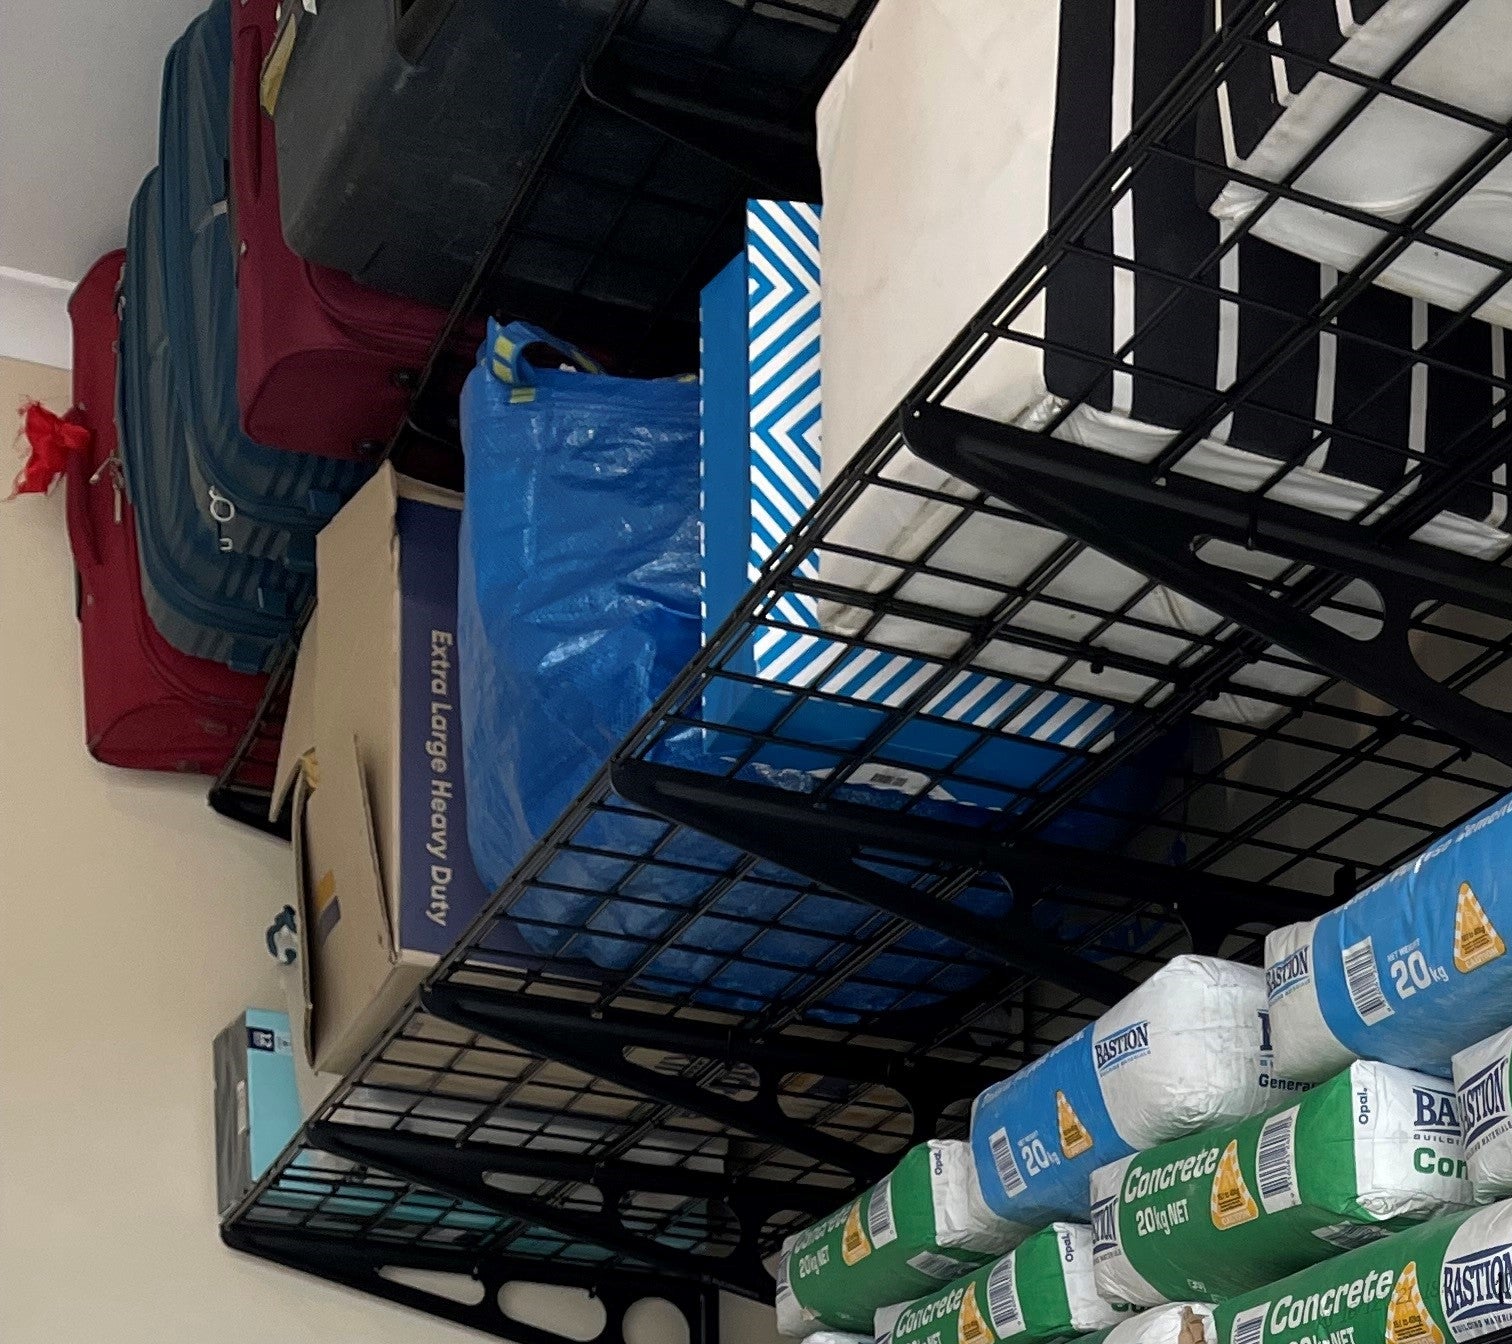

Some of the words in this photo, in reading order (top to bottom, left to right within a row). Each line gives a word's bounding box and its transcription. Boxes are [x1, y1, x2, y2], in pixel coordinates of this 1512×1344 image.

[431, 630, 453, 695] Extra
[425, 701, 453, 773] Large
[426, 780, 453, 860] Heavy
[426, 865, 452, 927] Duty
[1095, 1022, 1149, 1069] BASTION
[1458, 1060, 1509, 1129] ASTION
[1125, 1147, 1220, 1204] Concrete
[1136, 1204, 1171, 1236] 20kg
[1168, 1198, 1190, 1228] NET
[896, 1287, 965, 1339] Concrete
[1270, 1269, 1394, 1335] Concrete
